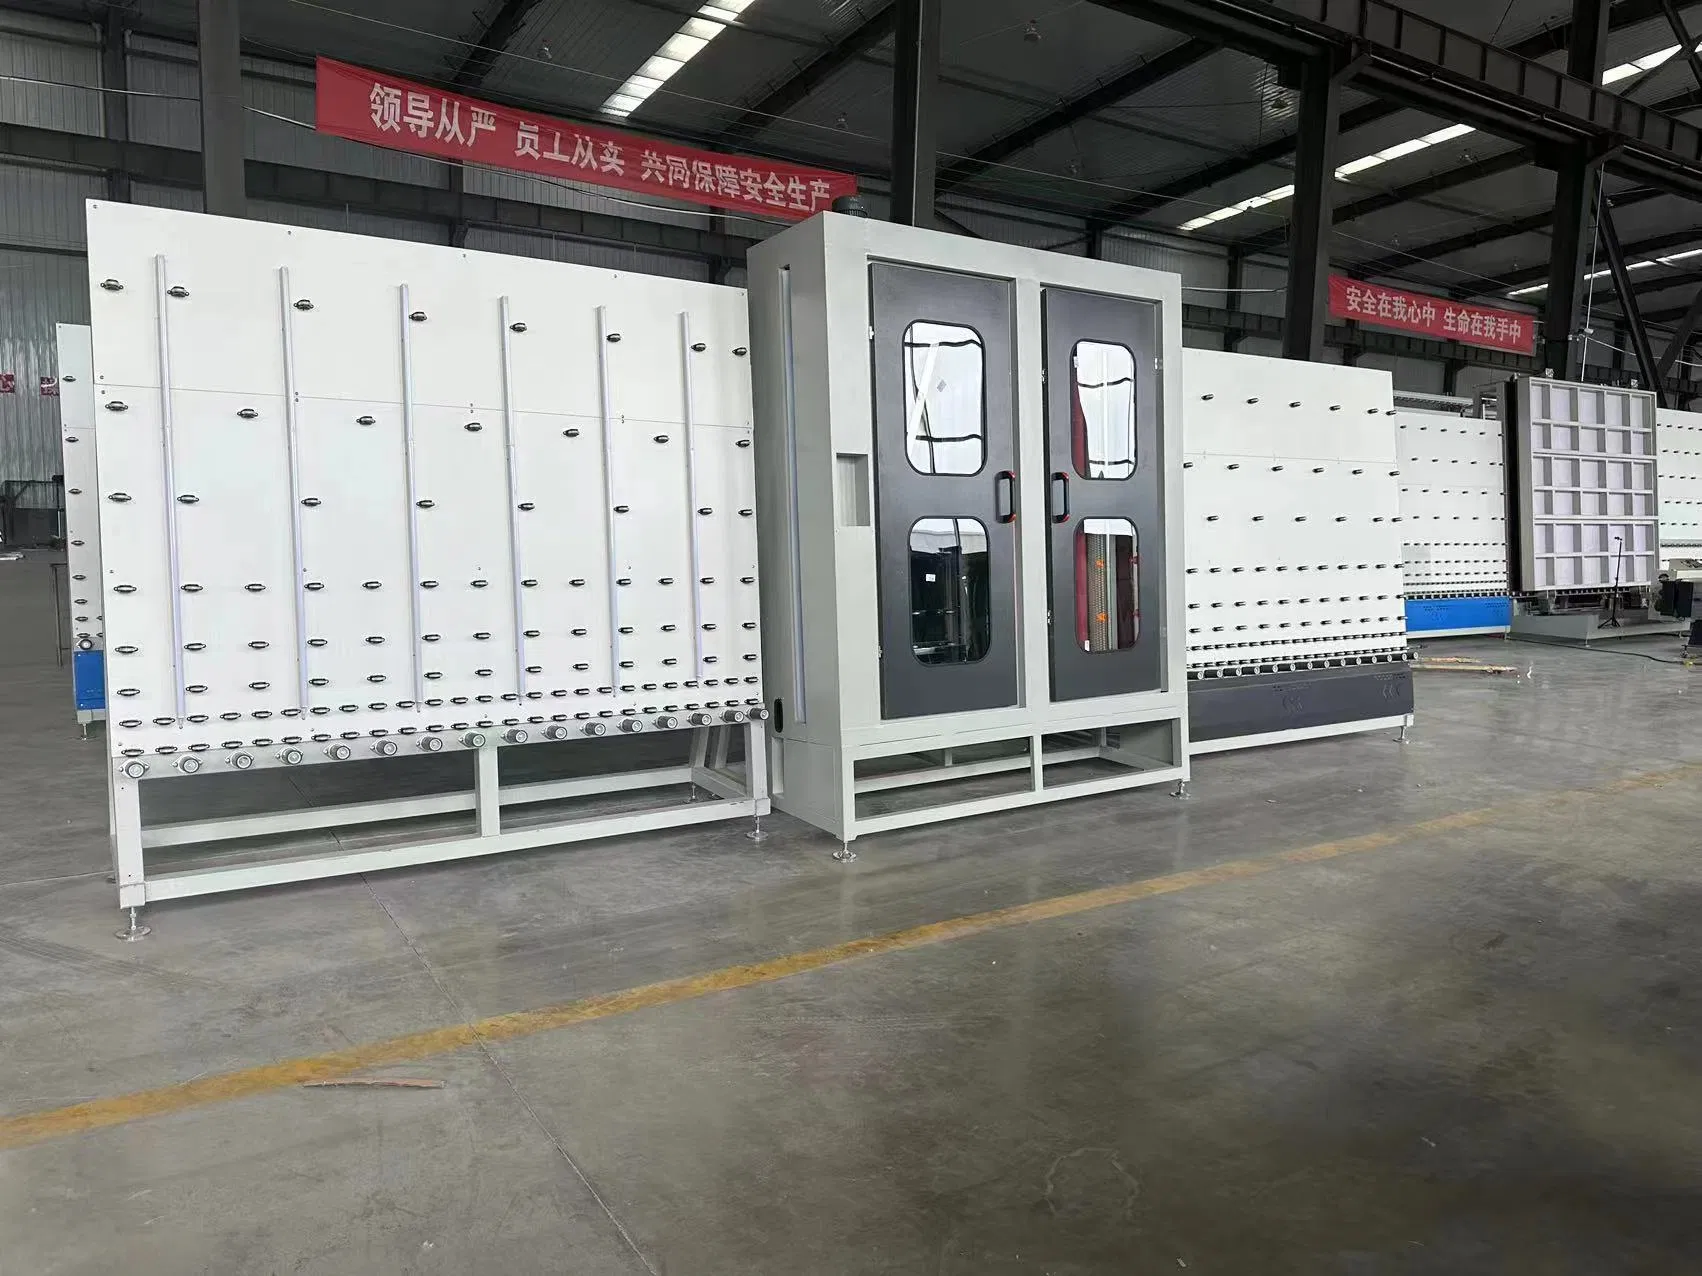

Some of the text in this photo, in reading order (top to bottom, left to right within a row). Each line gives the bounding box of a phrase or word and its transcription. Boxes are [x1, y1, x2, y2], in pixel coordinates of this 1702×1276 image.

[369, 82, 830, 212] 领导从严 员工从实 共同保障安全生产
[1346, 286, 1521, 344] 安全在我心中 生命在我手中
